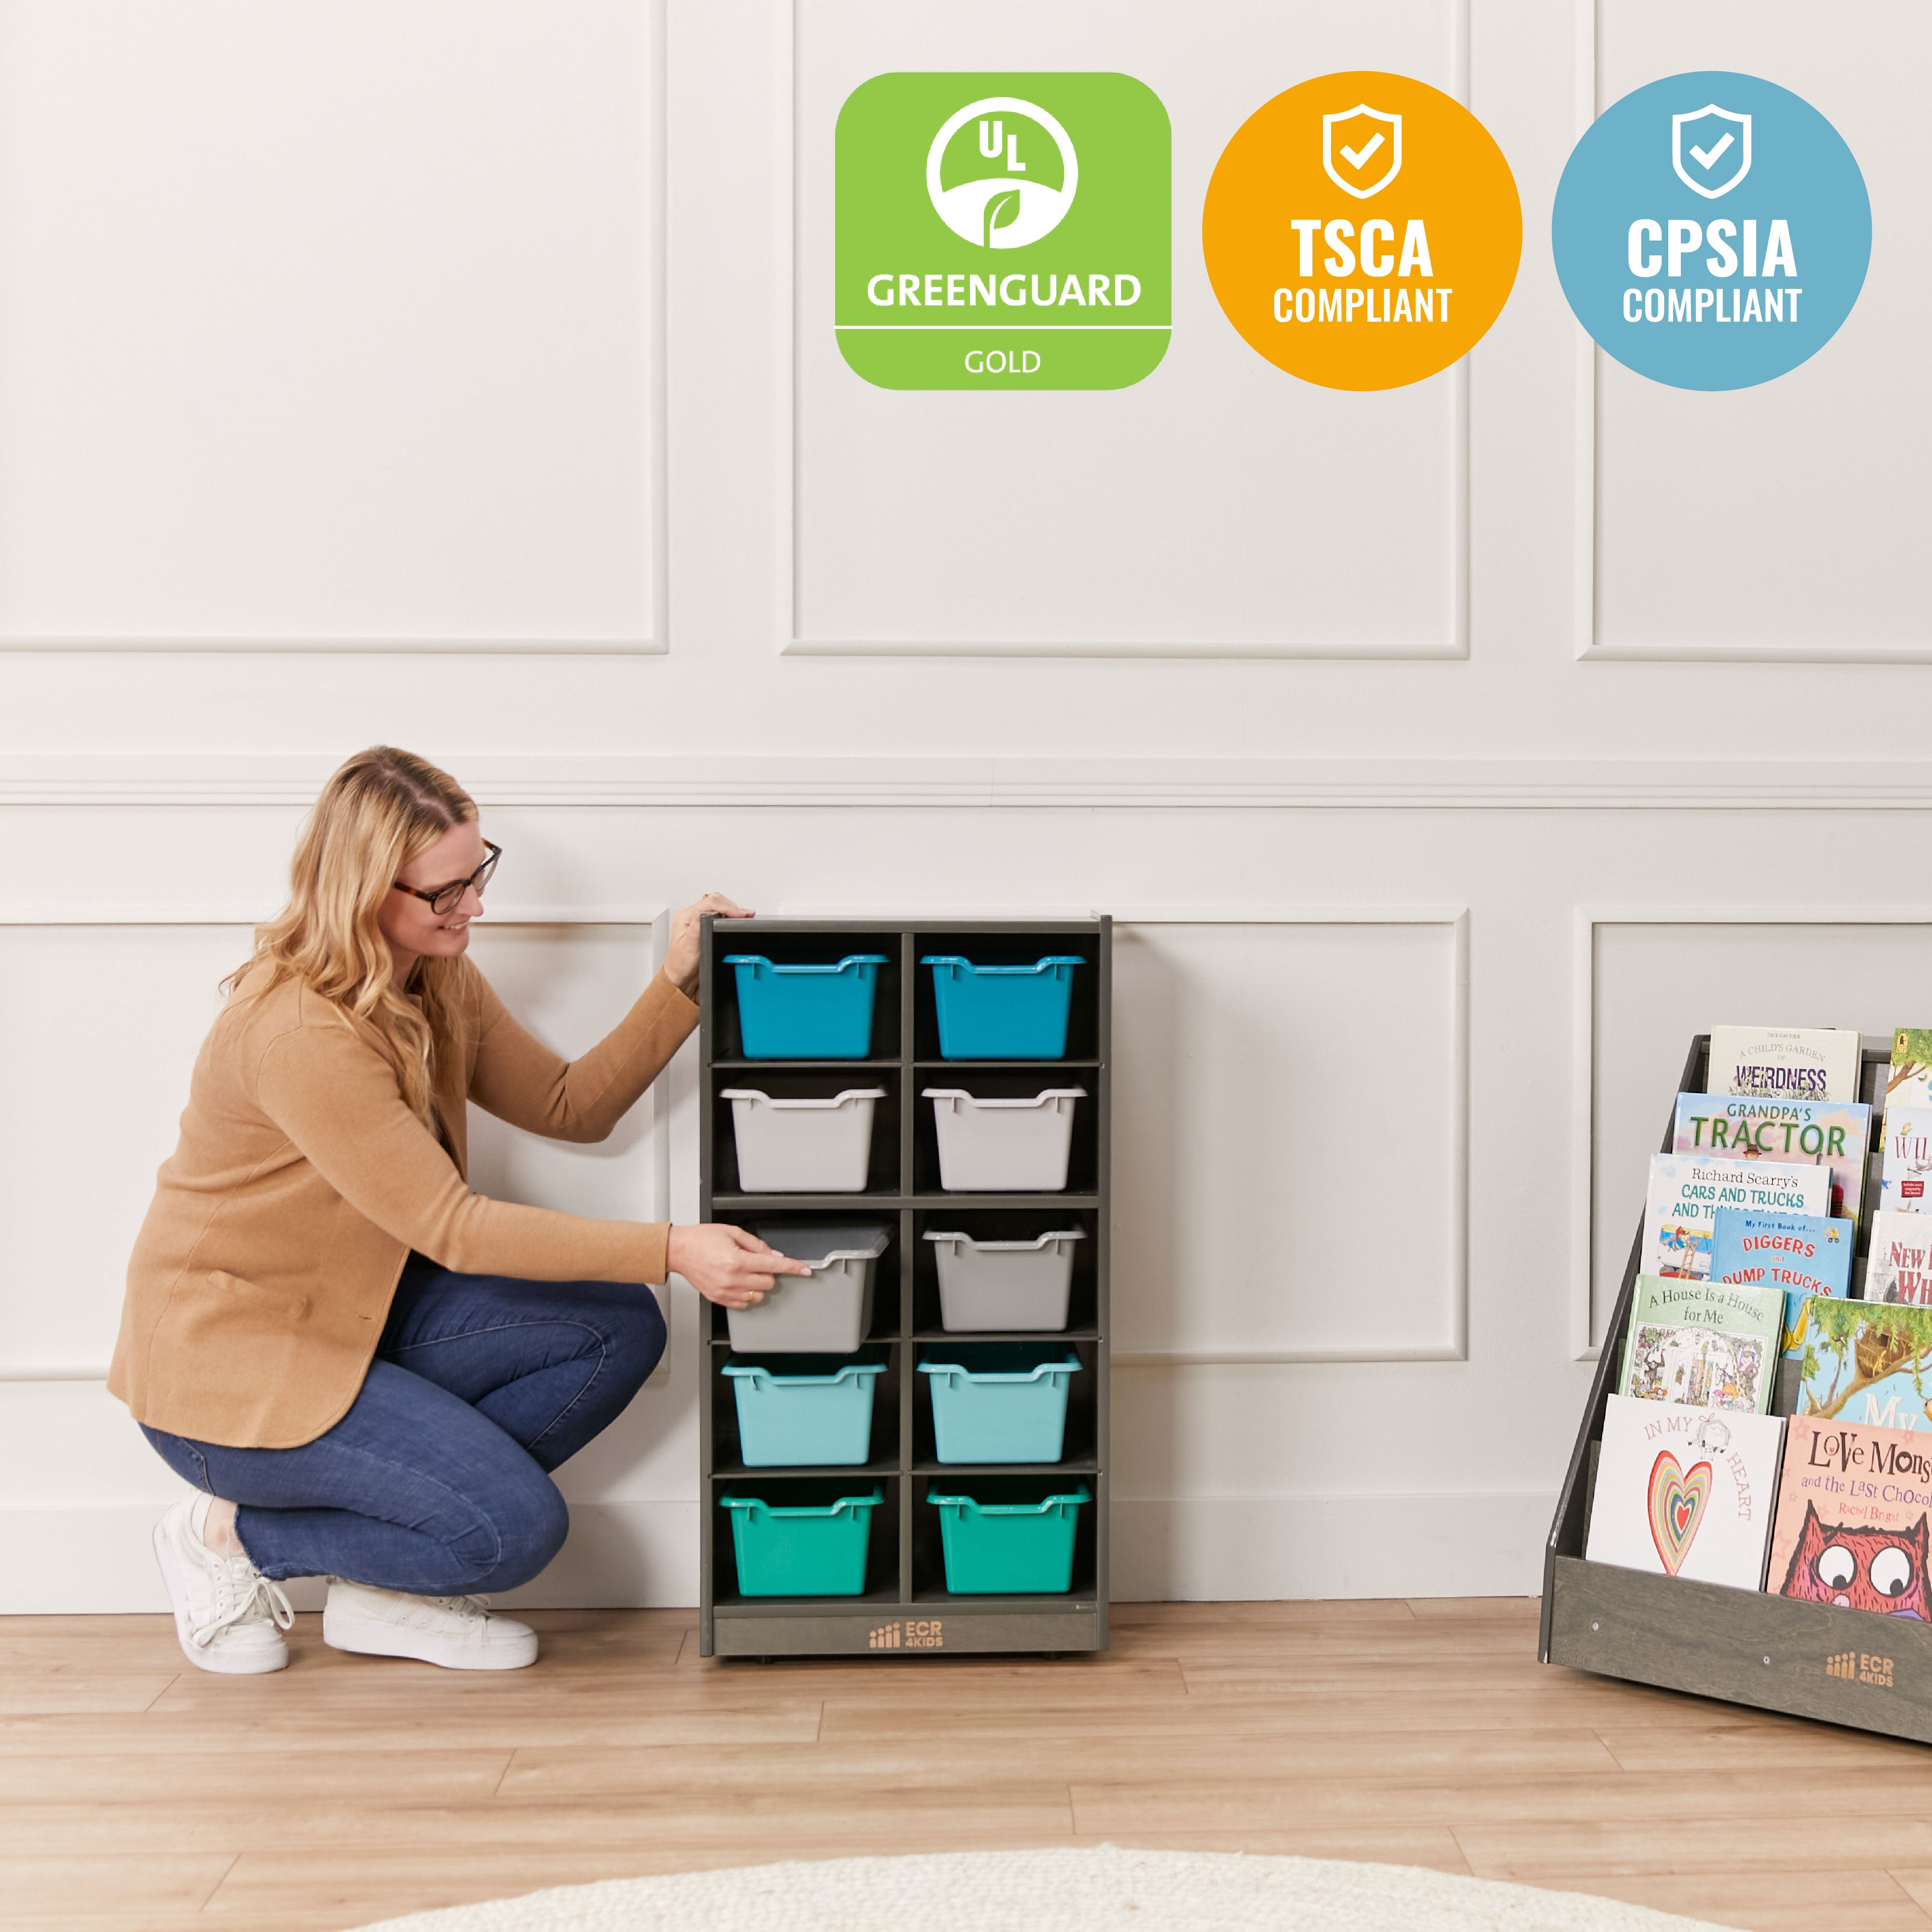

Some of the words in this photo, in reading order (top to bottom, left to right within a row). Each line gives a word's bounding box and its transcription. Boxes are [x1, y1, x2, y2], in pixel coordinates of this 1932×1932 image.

[1748, 1044, 1783, 1055] CHILD'S
[1786, 1045, 1825, 1062] GARDEN
[1736, 1065, 1826, 1091] WEIRDNESS
[1727, 1104, 1811, 1121] GRANDPA'S
[1690, 1117, 1846, 1156] TRACTOR
[1691, 1168, 1743, 1183] Richard
[1747, 1173, 1798, 1189] Scarry's
[1682, 1184, 1715, 1200] CARS
[1719, 1187, 1746, 1202] AND
[1750, 1190, 1804, 1208] TRUCKS
[1672, 1203, 1699, 1218] AND
[1746, 1220, 1755, 1228] My
[1743, 1235, 1816, 1257] DIGGERS
[1889, 1241, 1926, 1269] NEW
[1771, 1267, 1832, 1296] TRUCKS
[1649, 1294, 1659, 1308] A
[1662, 1289, 1701, 1303] House
[1705, 1288, 1715, 1301] Is
[1718, 1294, 1725, 1304] a
[1727, 1292, 1763, 1321] House
[1684, 1306, 1702, 1320] for
[1704, 1309, 1723, 1324] Me
[1644, 1420, 1662, 1440] IN
[1667, 1417, 1692, 1432] MY
[1726, 1451, 1751, 1521] HEART
[1802, 1477, 1821, 1487] and
[1825, 1475, 1845, 1493] the
[1839, 1503, 1867, 1519] Rachel
[1870, 1506, 1900, 1522] Bright
[906, 1621, 941, 1636] ECR
[905, 1637, 943, 1648] 4KIDS
[1860, 1653, 1893, 1675] ECR
[1859, 1671, 1893, 1687] 4KIDS
